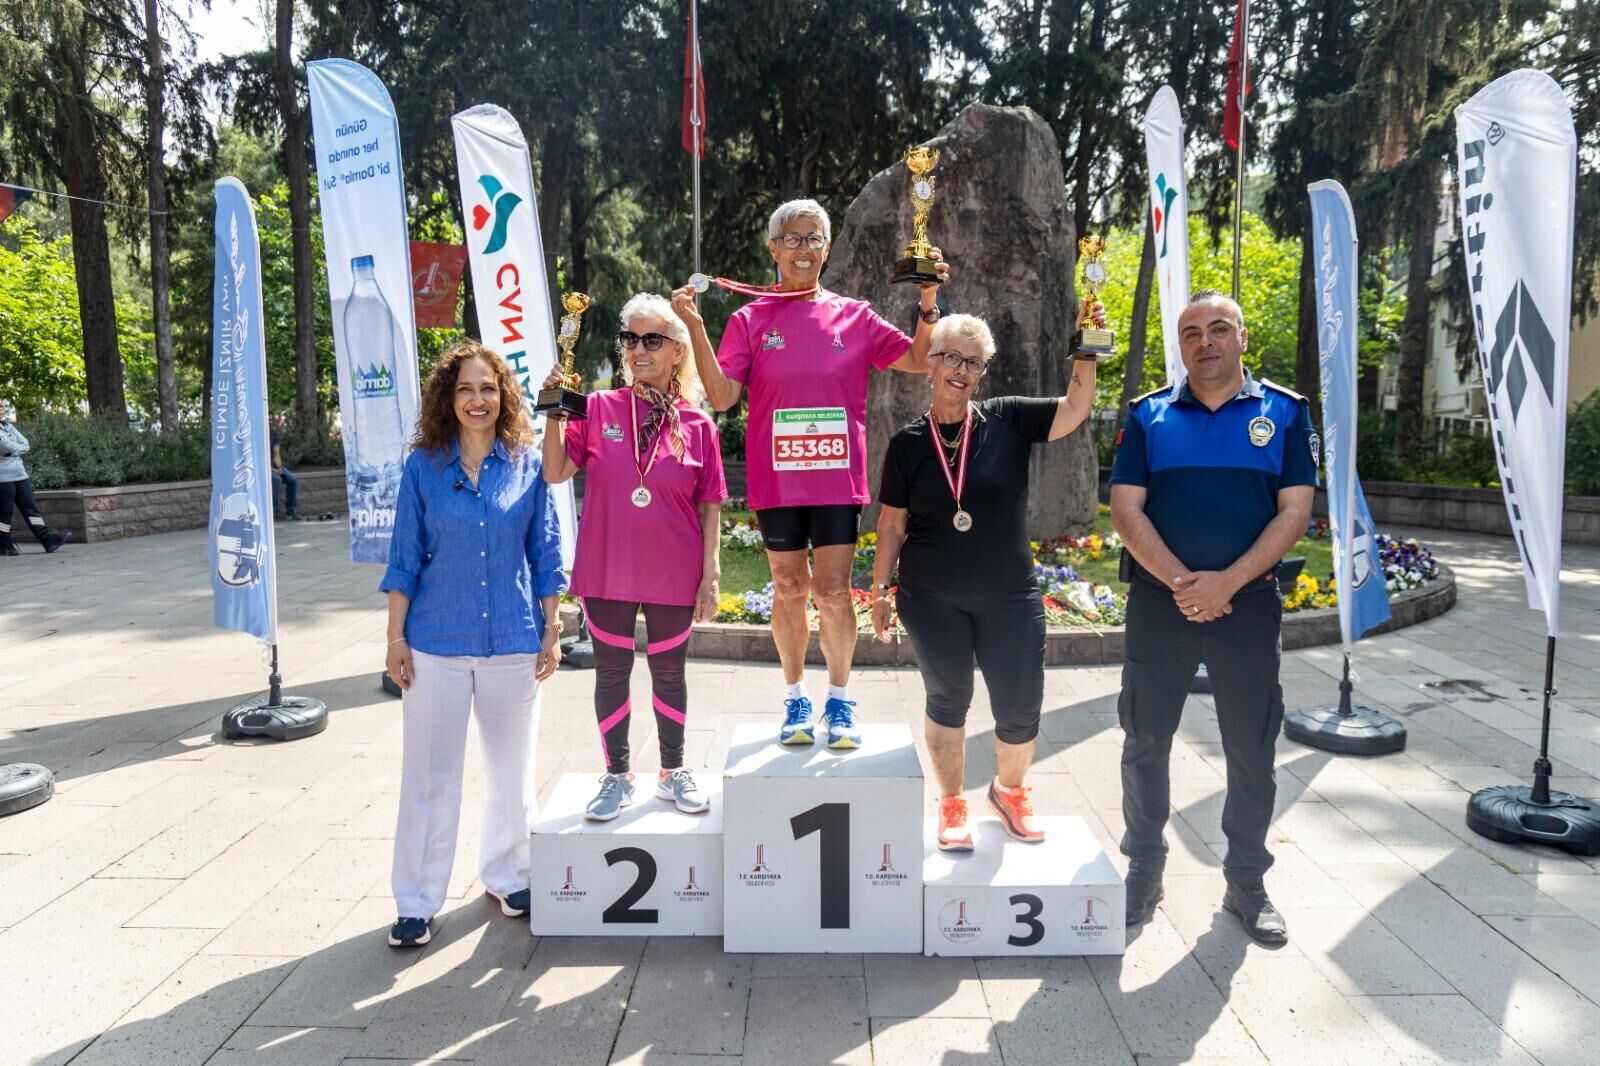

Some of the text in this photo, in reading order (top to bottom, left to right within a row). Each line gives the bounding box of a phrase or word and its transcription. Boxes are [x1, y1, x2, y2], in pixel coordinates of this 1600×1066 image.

[777, 438, 845, 458] 35368
[603, 848, 658, 923] 2
[790, 803, 850, 929] 1
[1008, 893, 1045, 946] 3
